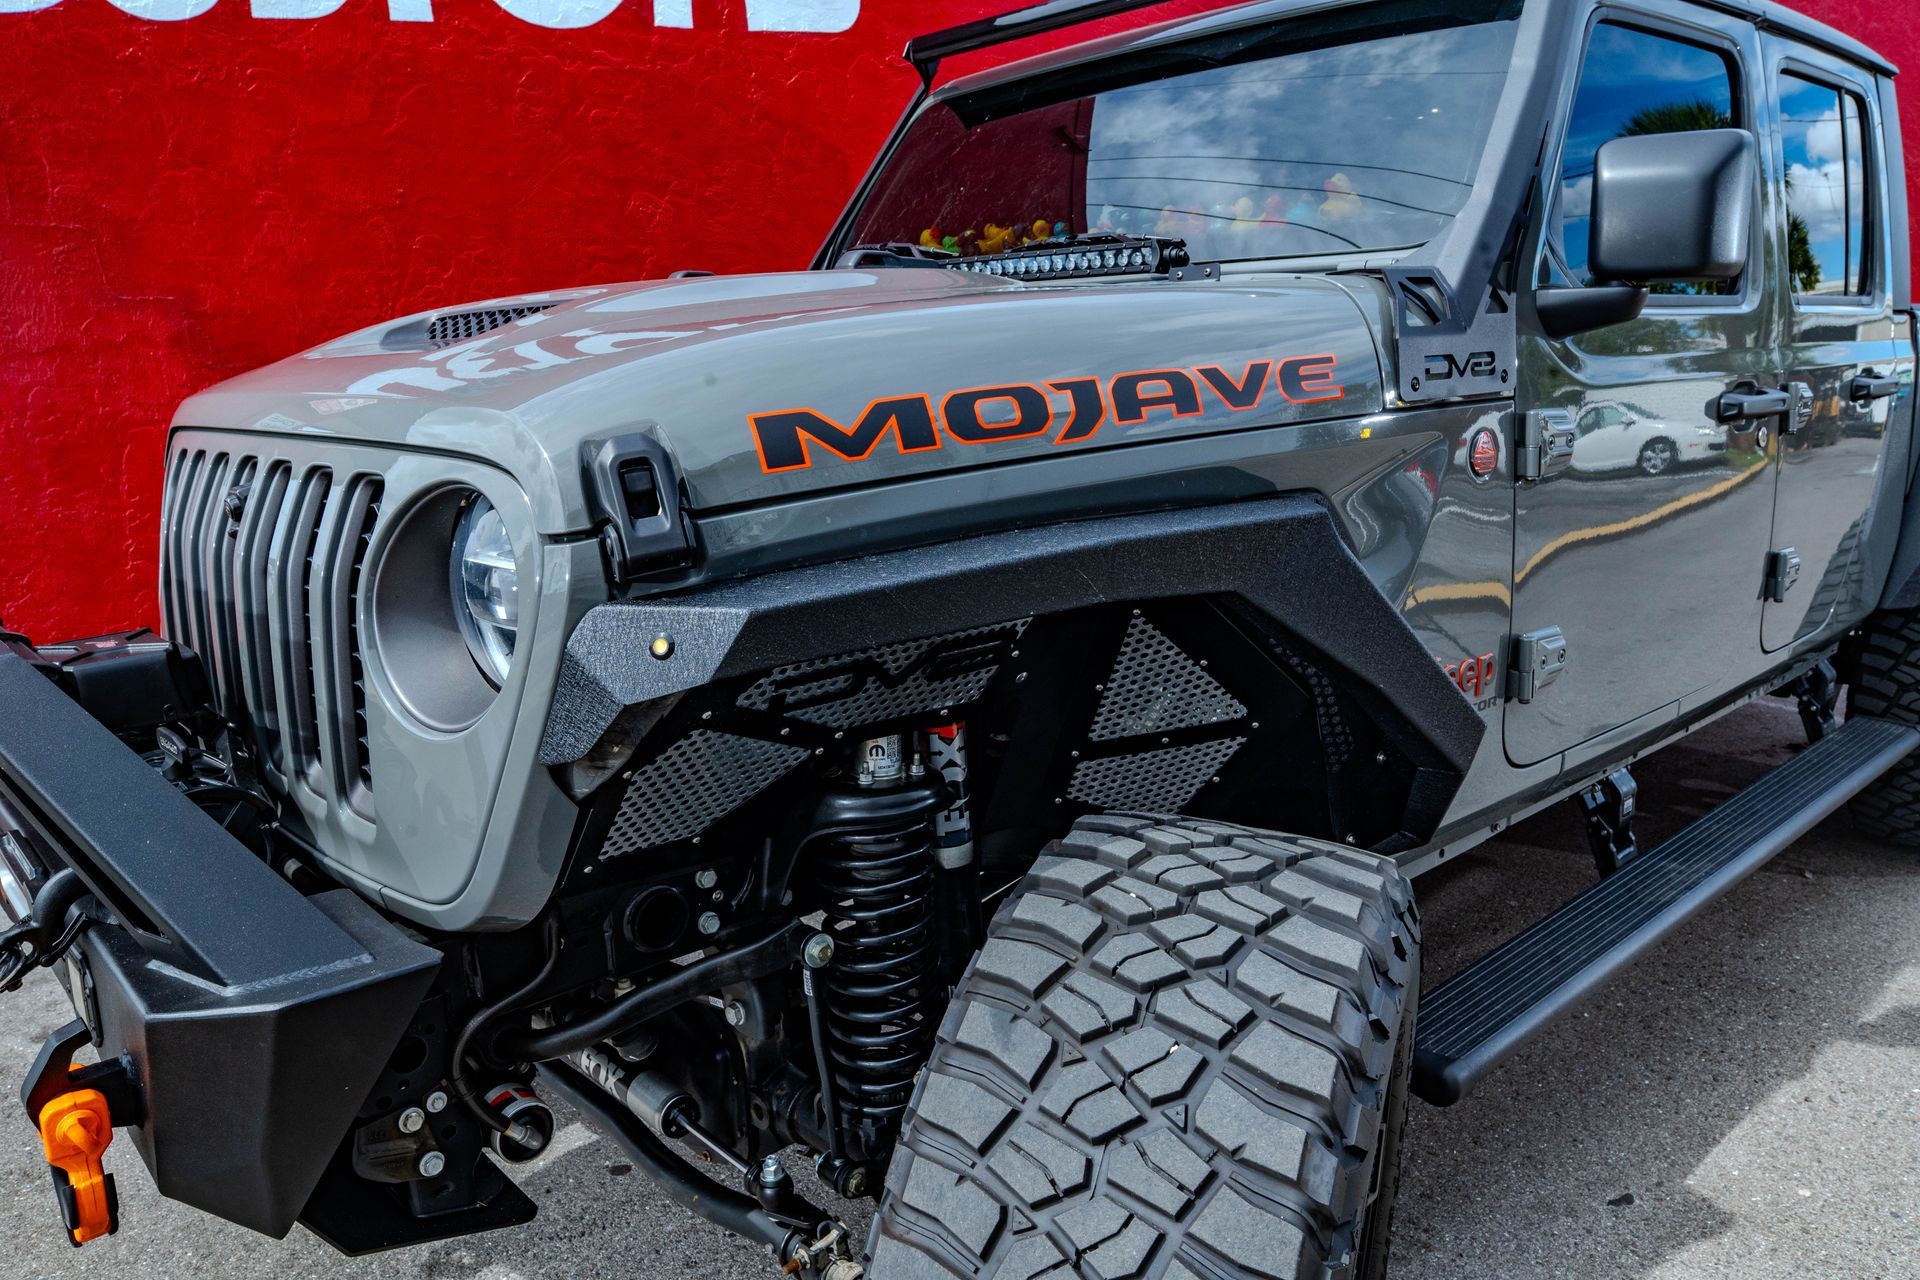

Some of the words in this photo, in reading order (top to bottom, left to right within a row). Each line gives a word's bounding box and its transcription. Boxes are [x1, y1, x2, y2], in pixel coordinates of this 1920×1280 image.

[1424, 350, 1496, 382] DV8
[746, 353, 1344, 474] MOJAVE
[581, 1047, 627, 1101] FOX
